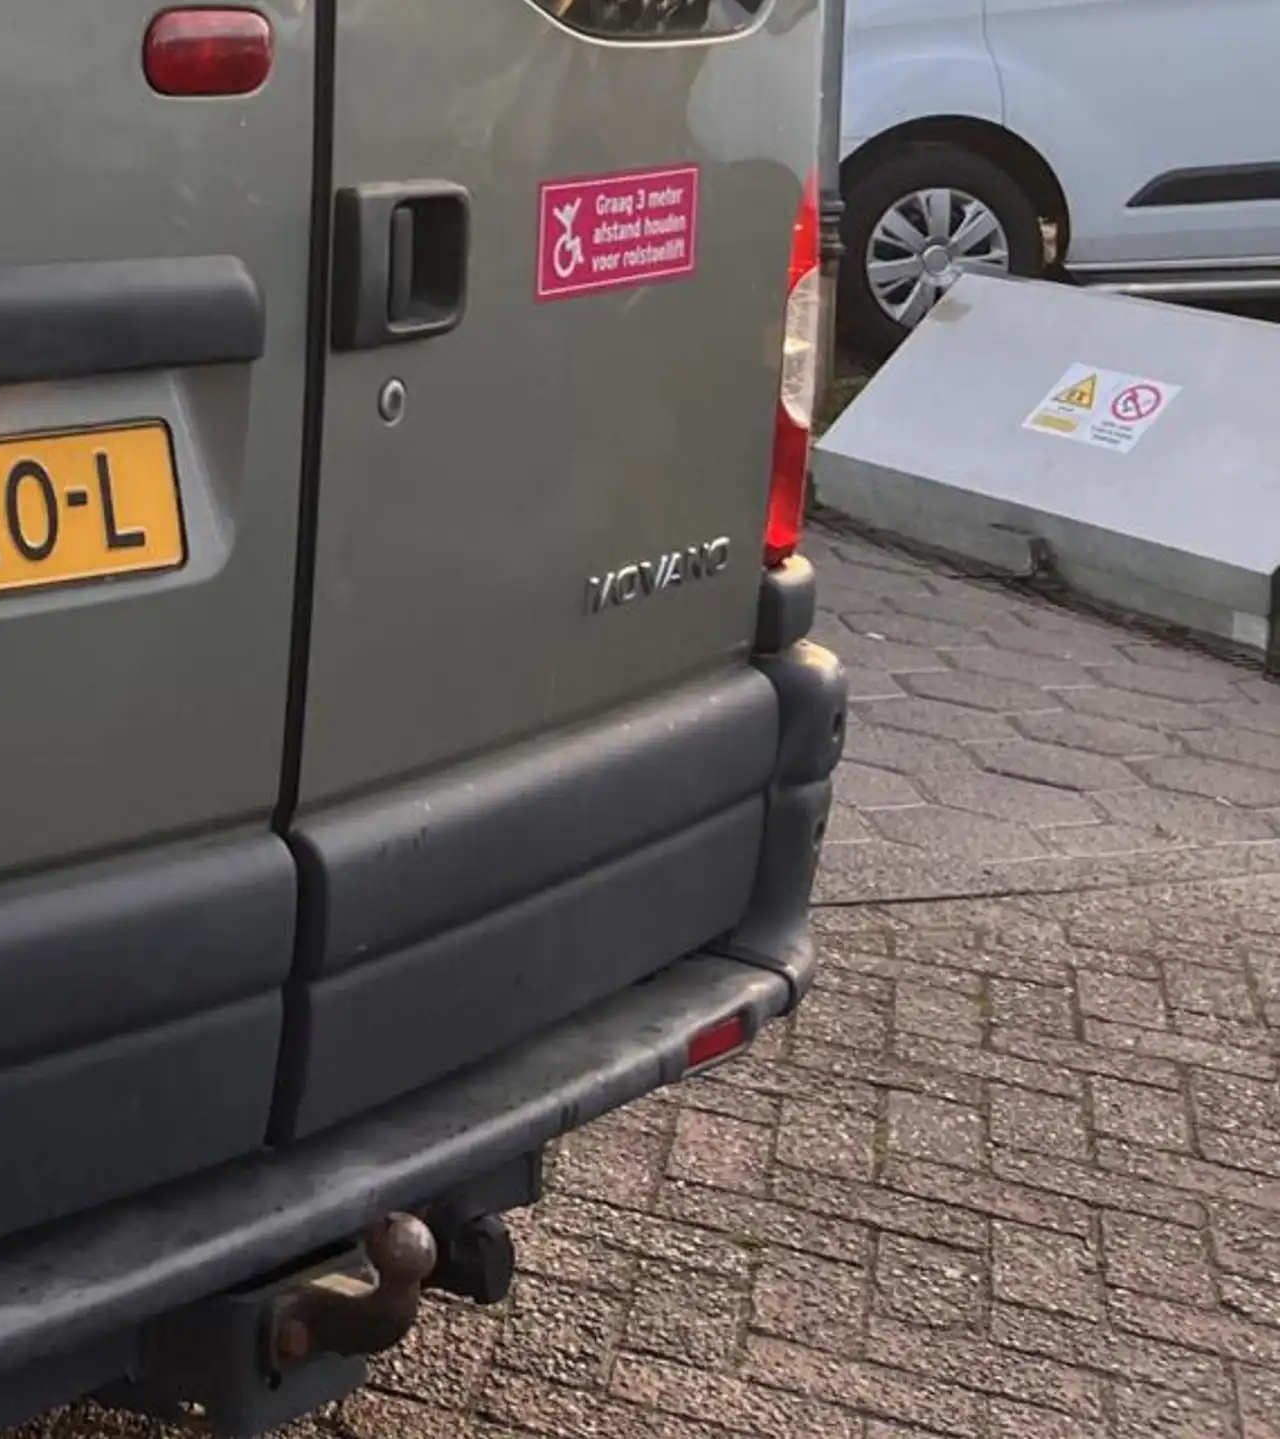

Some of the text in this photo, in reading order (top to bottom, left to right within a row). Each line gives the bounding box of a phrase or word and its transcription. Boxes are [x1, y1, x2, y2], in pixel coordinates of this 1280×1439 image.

[595, 186, 684, 216] Graag 3 meter
[592, 213, 686, 244] afstand houden
[592, 252, 620, 272] voor
[583, 535, 730, 614] MOVANO
